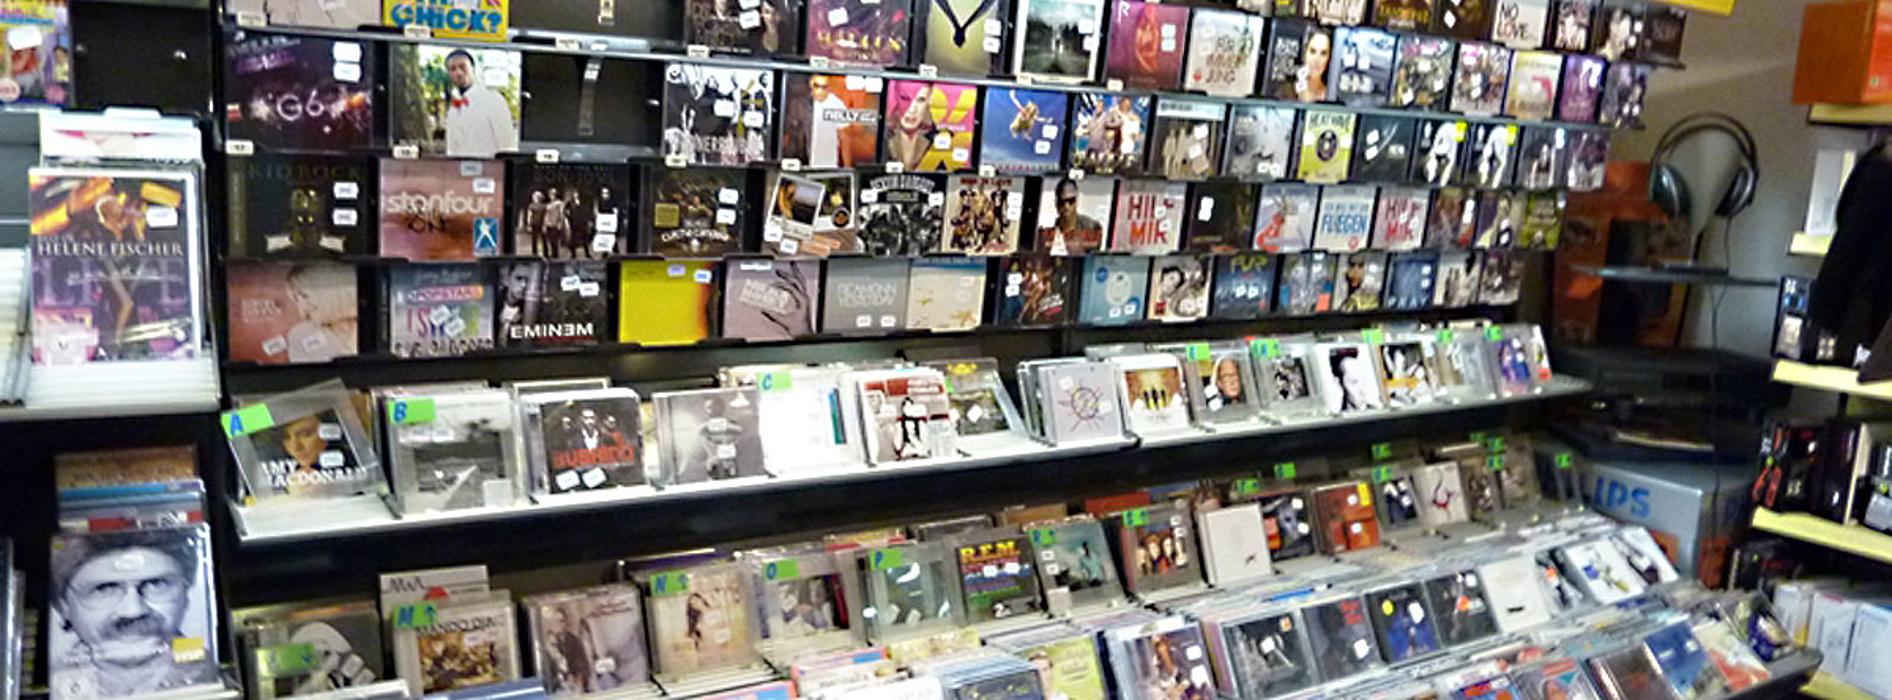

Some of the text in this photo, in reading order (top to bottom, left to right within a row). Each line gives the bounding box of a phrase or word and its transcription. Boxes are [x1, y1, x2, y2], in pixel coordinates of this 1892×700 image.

[276, 89, 325, 121] G6
[37, 241, 184, 257] HELENE FISCHER
[393, 401, 408, 423] B
[229, 413, 244, 438] A
